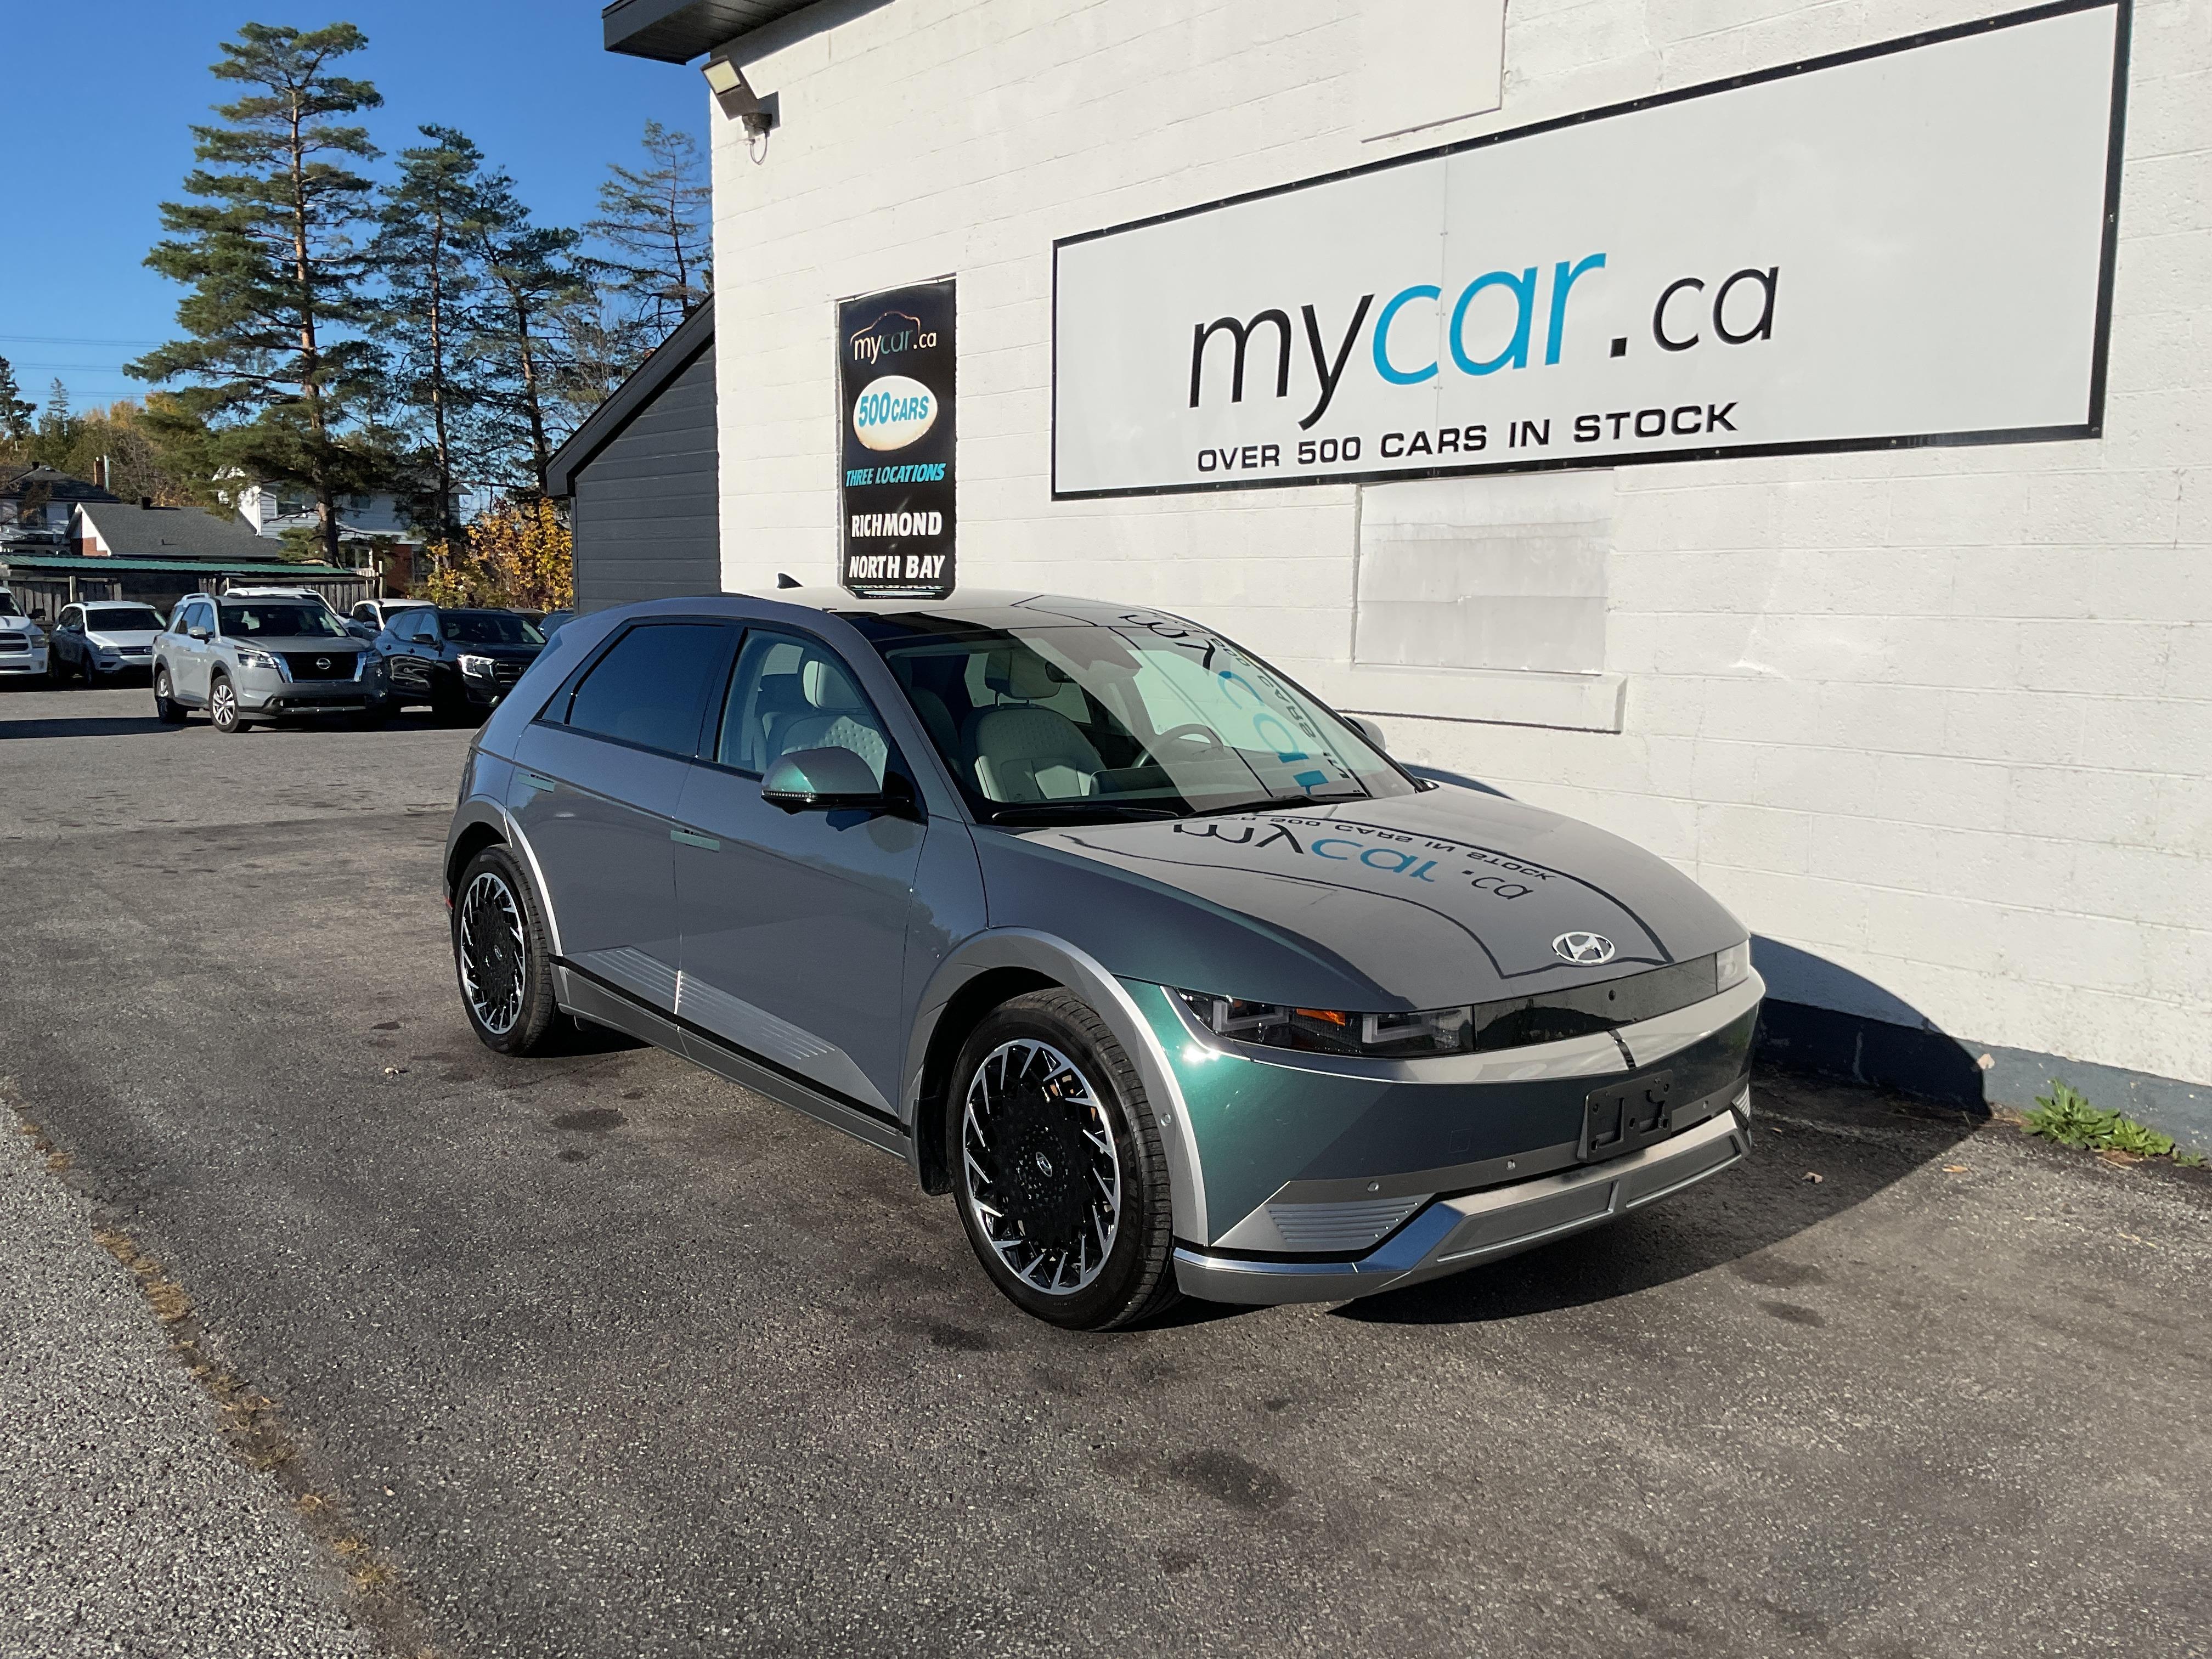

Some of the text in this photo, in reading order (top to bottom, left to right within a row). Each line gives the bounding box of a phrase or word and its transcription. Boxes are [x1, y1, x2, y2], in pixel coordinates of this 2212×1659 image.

[854, 329, 936, 364] mycar.ca
[1198, 402, 1739, 472] OVER 500 CARS IN STOCK
[845, 462, 946, 487] THREE LOCATIONS
[851, 511, 943, 538] RICHMOND
[849, 555, 945, 579] NORTH BAY
